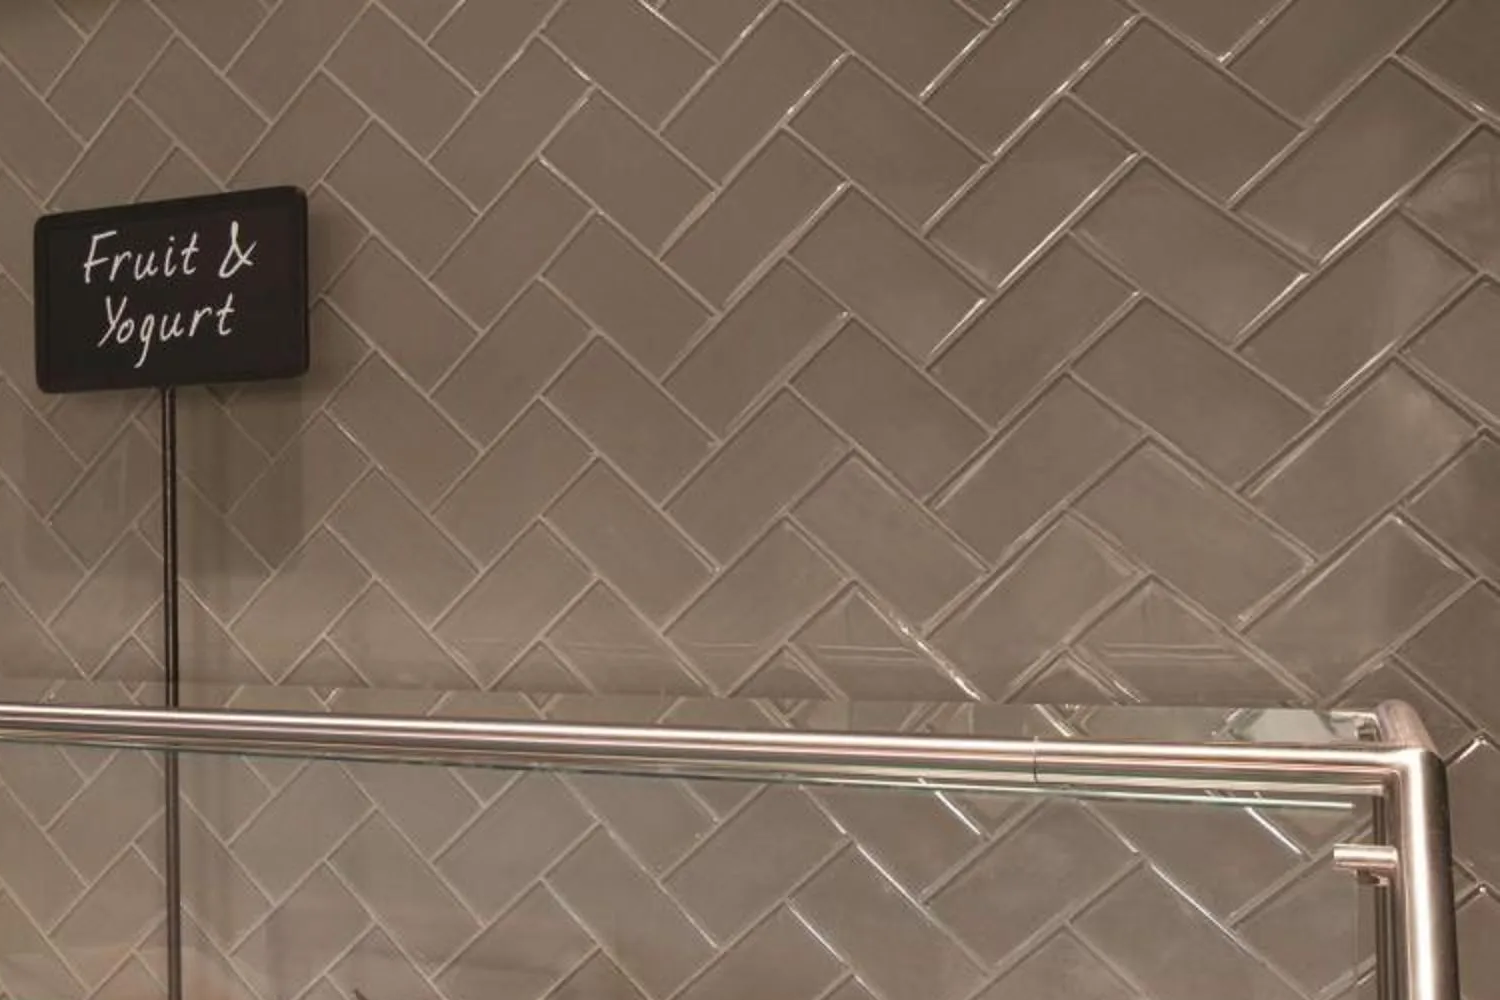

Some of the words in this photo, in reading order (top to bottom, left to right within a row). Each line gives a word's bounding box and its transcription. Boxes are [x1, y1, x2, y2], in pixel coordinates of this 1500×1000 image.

[83, 230, 198, 284] Fruit
[219, 220, 257, 278] &
[97, 292, 235, 368] Yogurt
